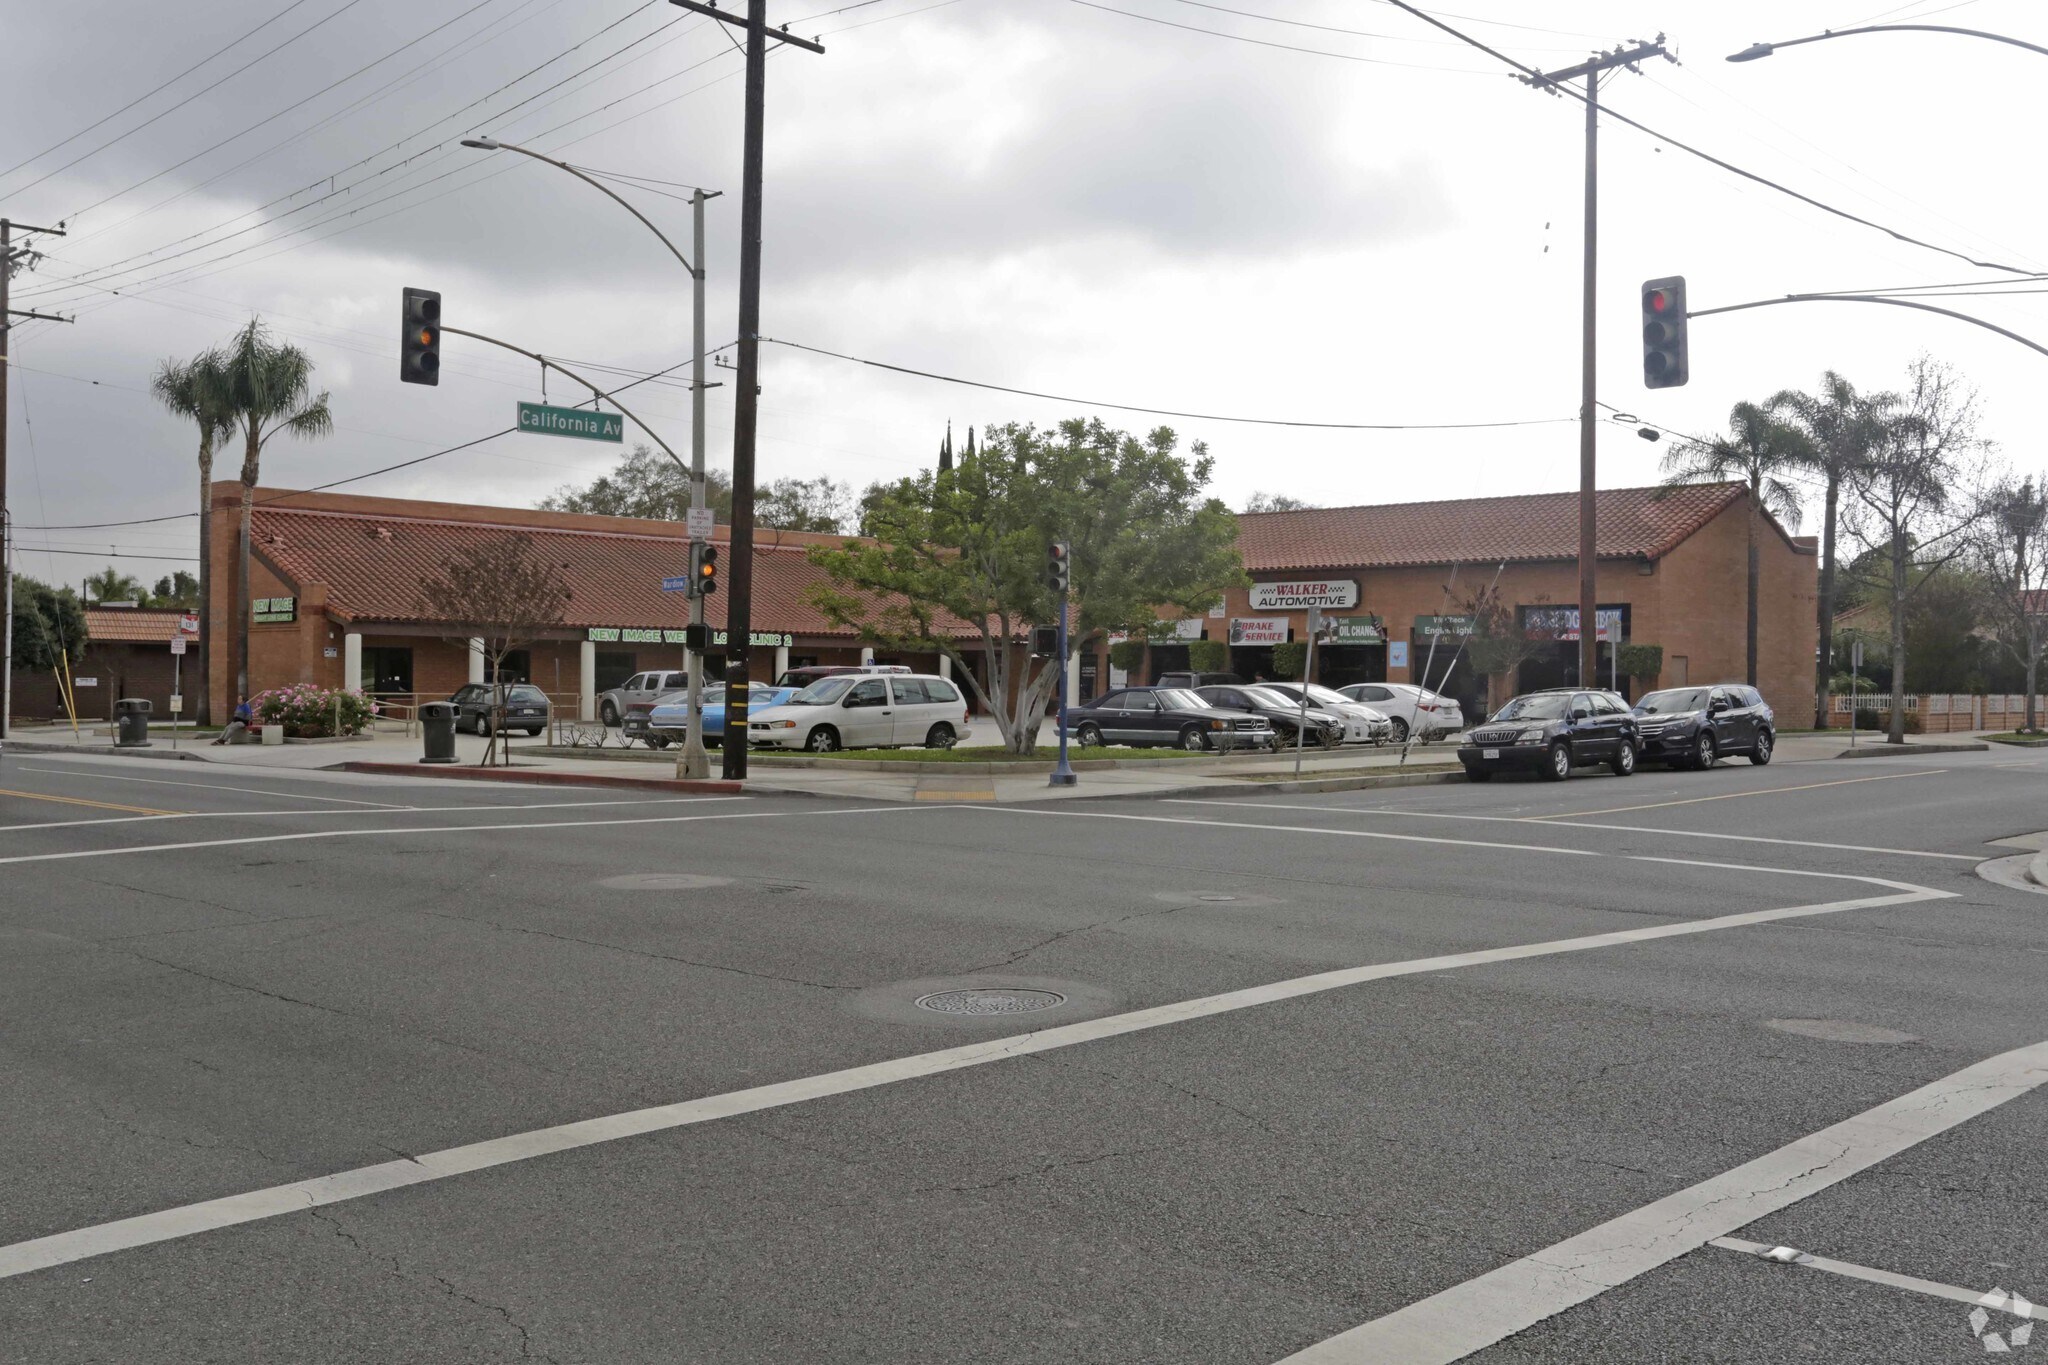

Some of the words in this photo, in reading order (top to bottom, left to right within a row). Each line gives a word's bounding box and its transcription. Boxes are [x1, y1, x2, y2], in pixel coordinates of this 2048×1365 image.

[521, 409, 598, 433] California
[603, 420, 621, 436] Av
[1276, 583, 1328, 595] WALKER
[253, 599, 269, 612] NEW
[271, 597, 293, 612] IMAGE
[1258, 595, 1346, 606] AUTOMOTIVE
[1241, 622, 1274, 630] BRAKE
[1339, 625, 1350, 636] OIL
[1453, 626, 1472, 636] ight
[589, 629, 619, 641] NEW
[622, 630, 661, 642] IMAGE
[784, 634, 793, 646] 2
[1245, 632, 1284, 641] SERVICE
